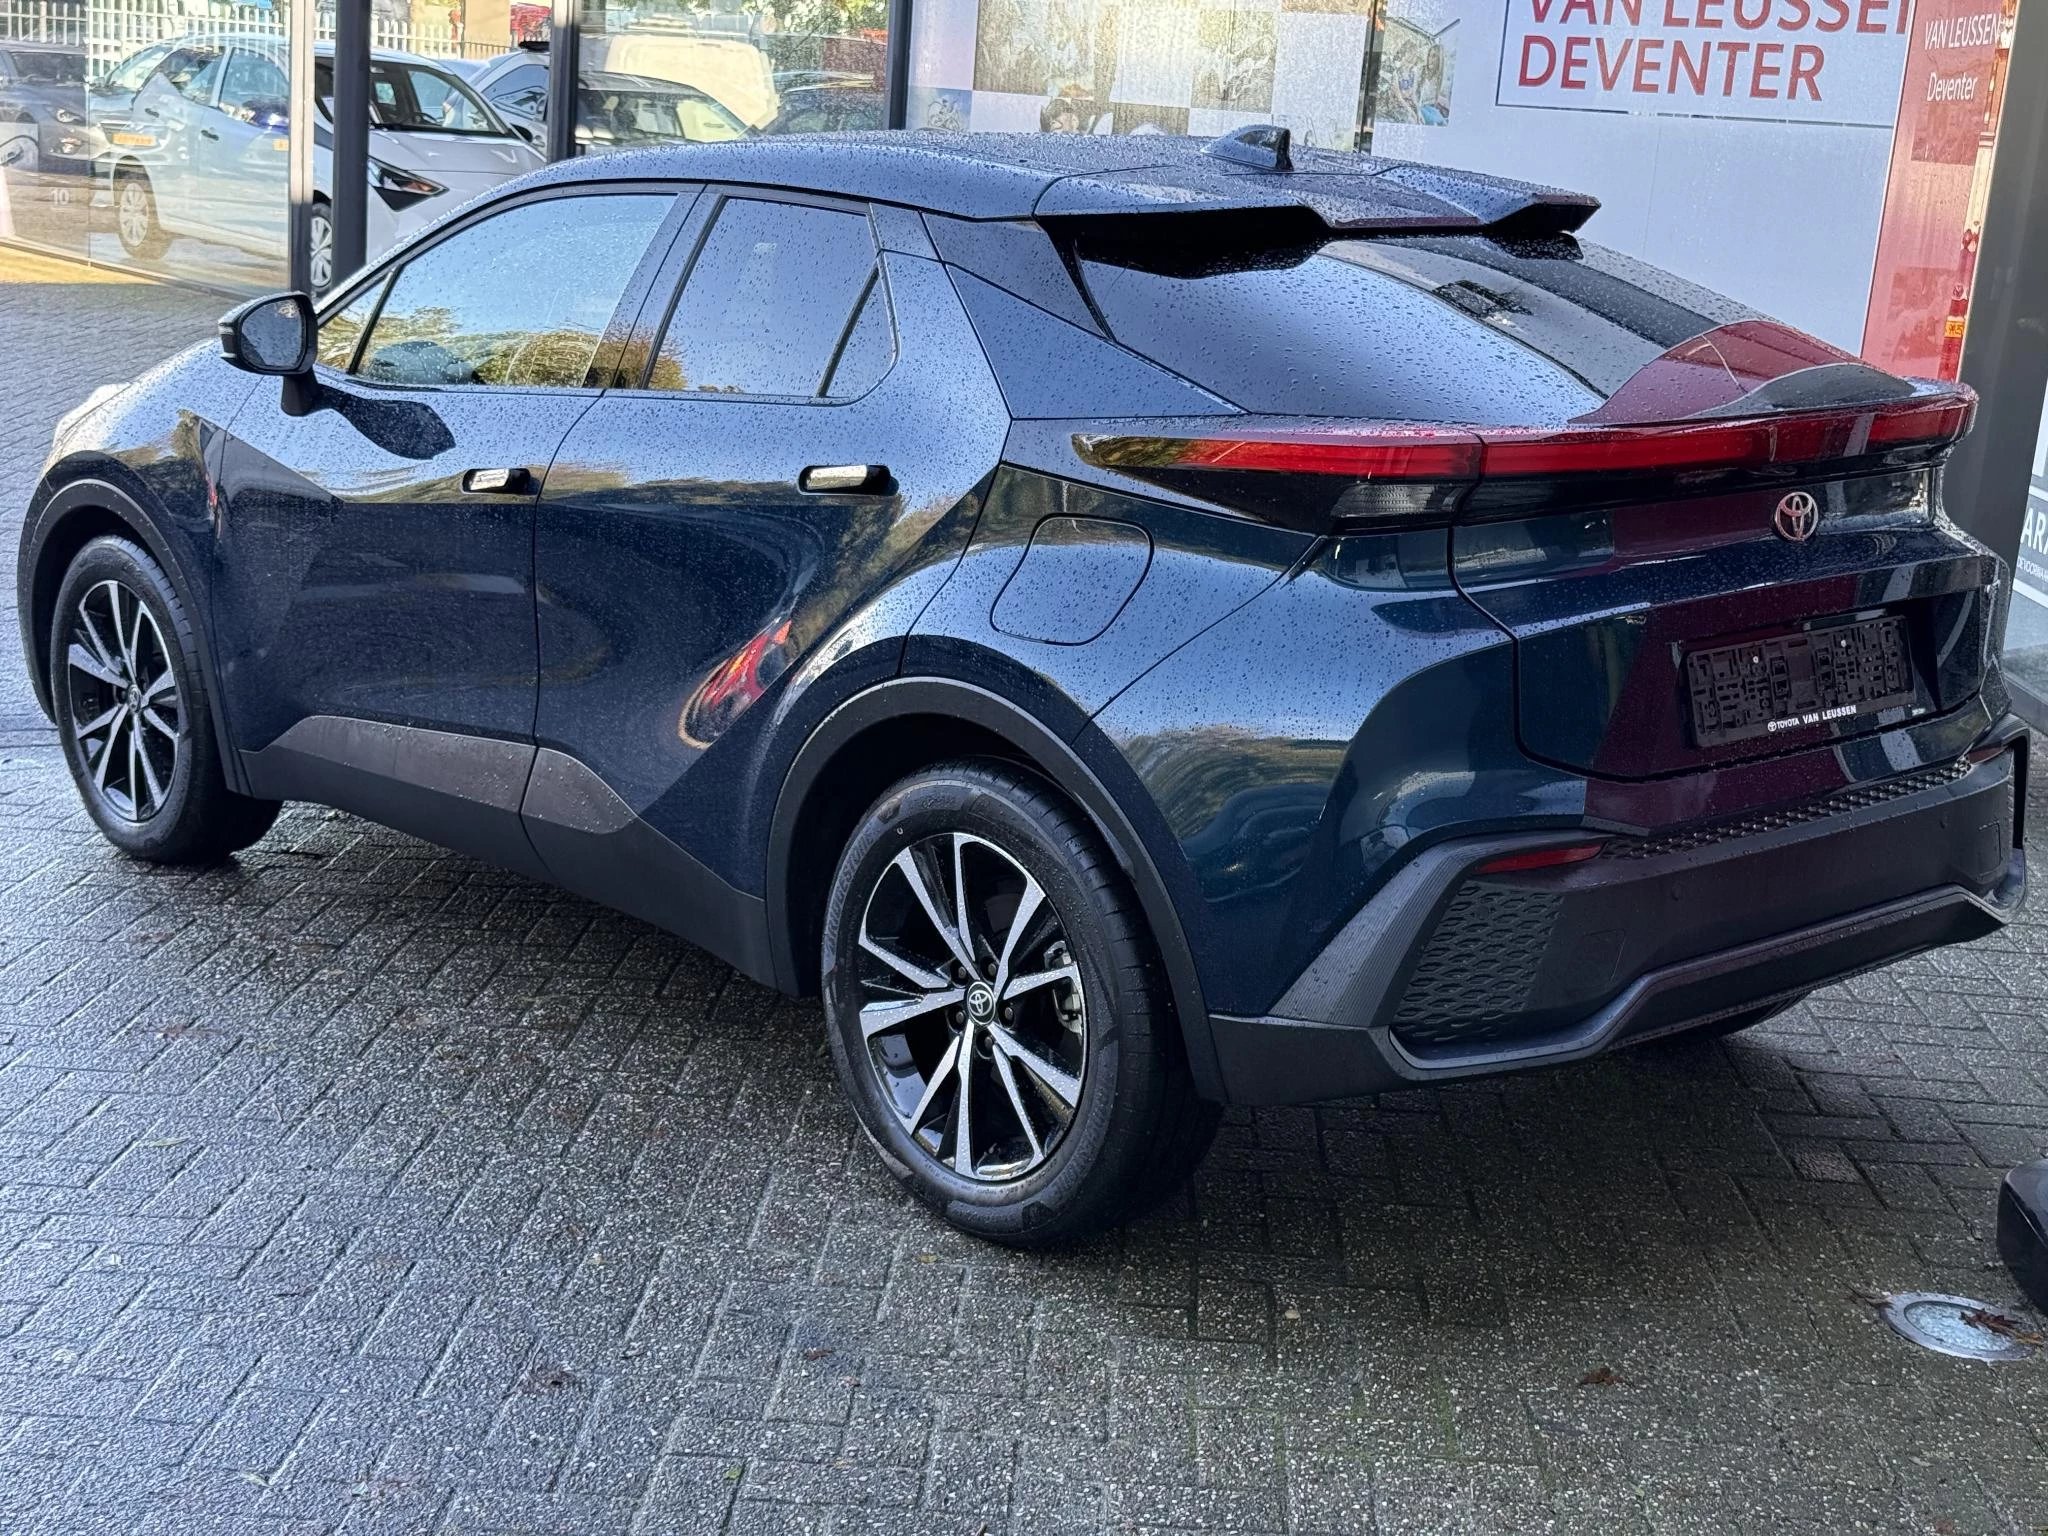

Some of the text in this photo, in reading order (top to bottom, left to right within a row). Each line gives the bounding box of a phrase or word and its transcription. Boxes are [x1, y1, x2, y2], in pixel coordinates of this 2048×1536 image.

[1662, 0, 1908, 34] LEUSSE
[1924, 13, 2001, 50] VAN LEUSSEN
[1518, 35, 1823, 101] DEVENTER
[1927, 71, 1978, 101] Deventer
[1776, 704, 1857, 730] TOYOTA VAN LEUSSEN
